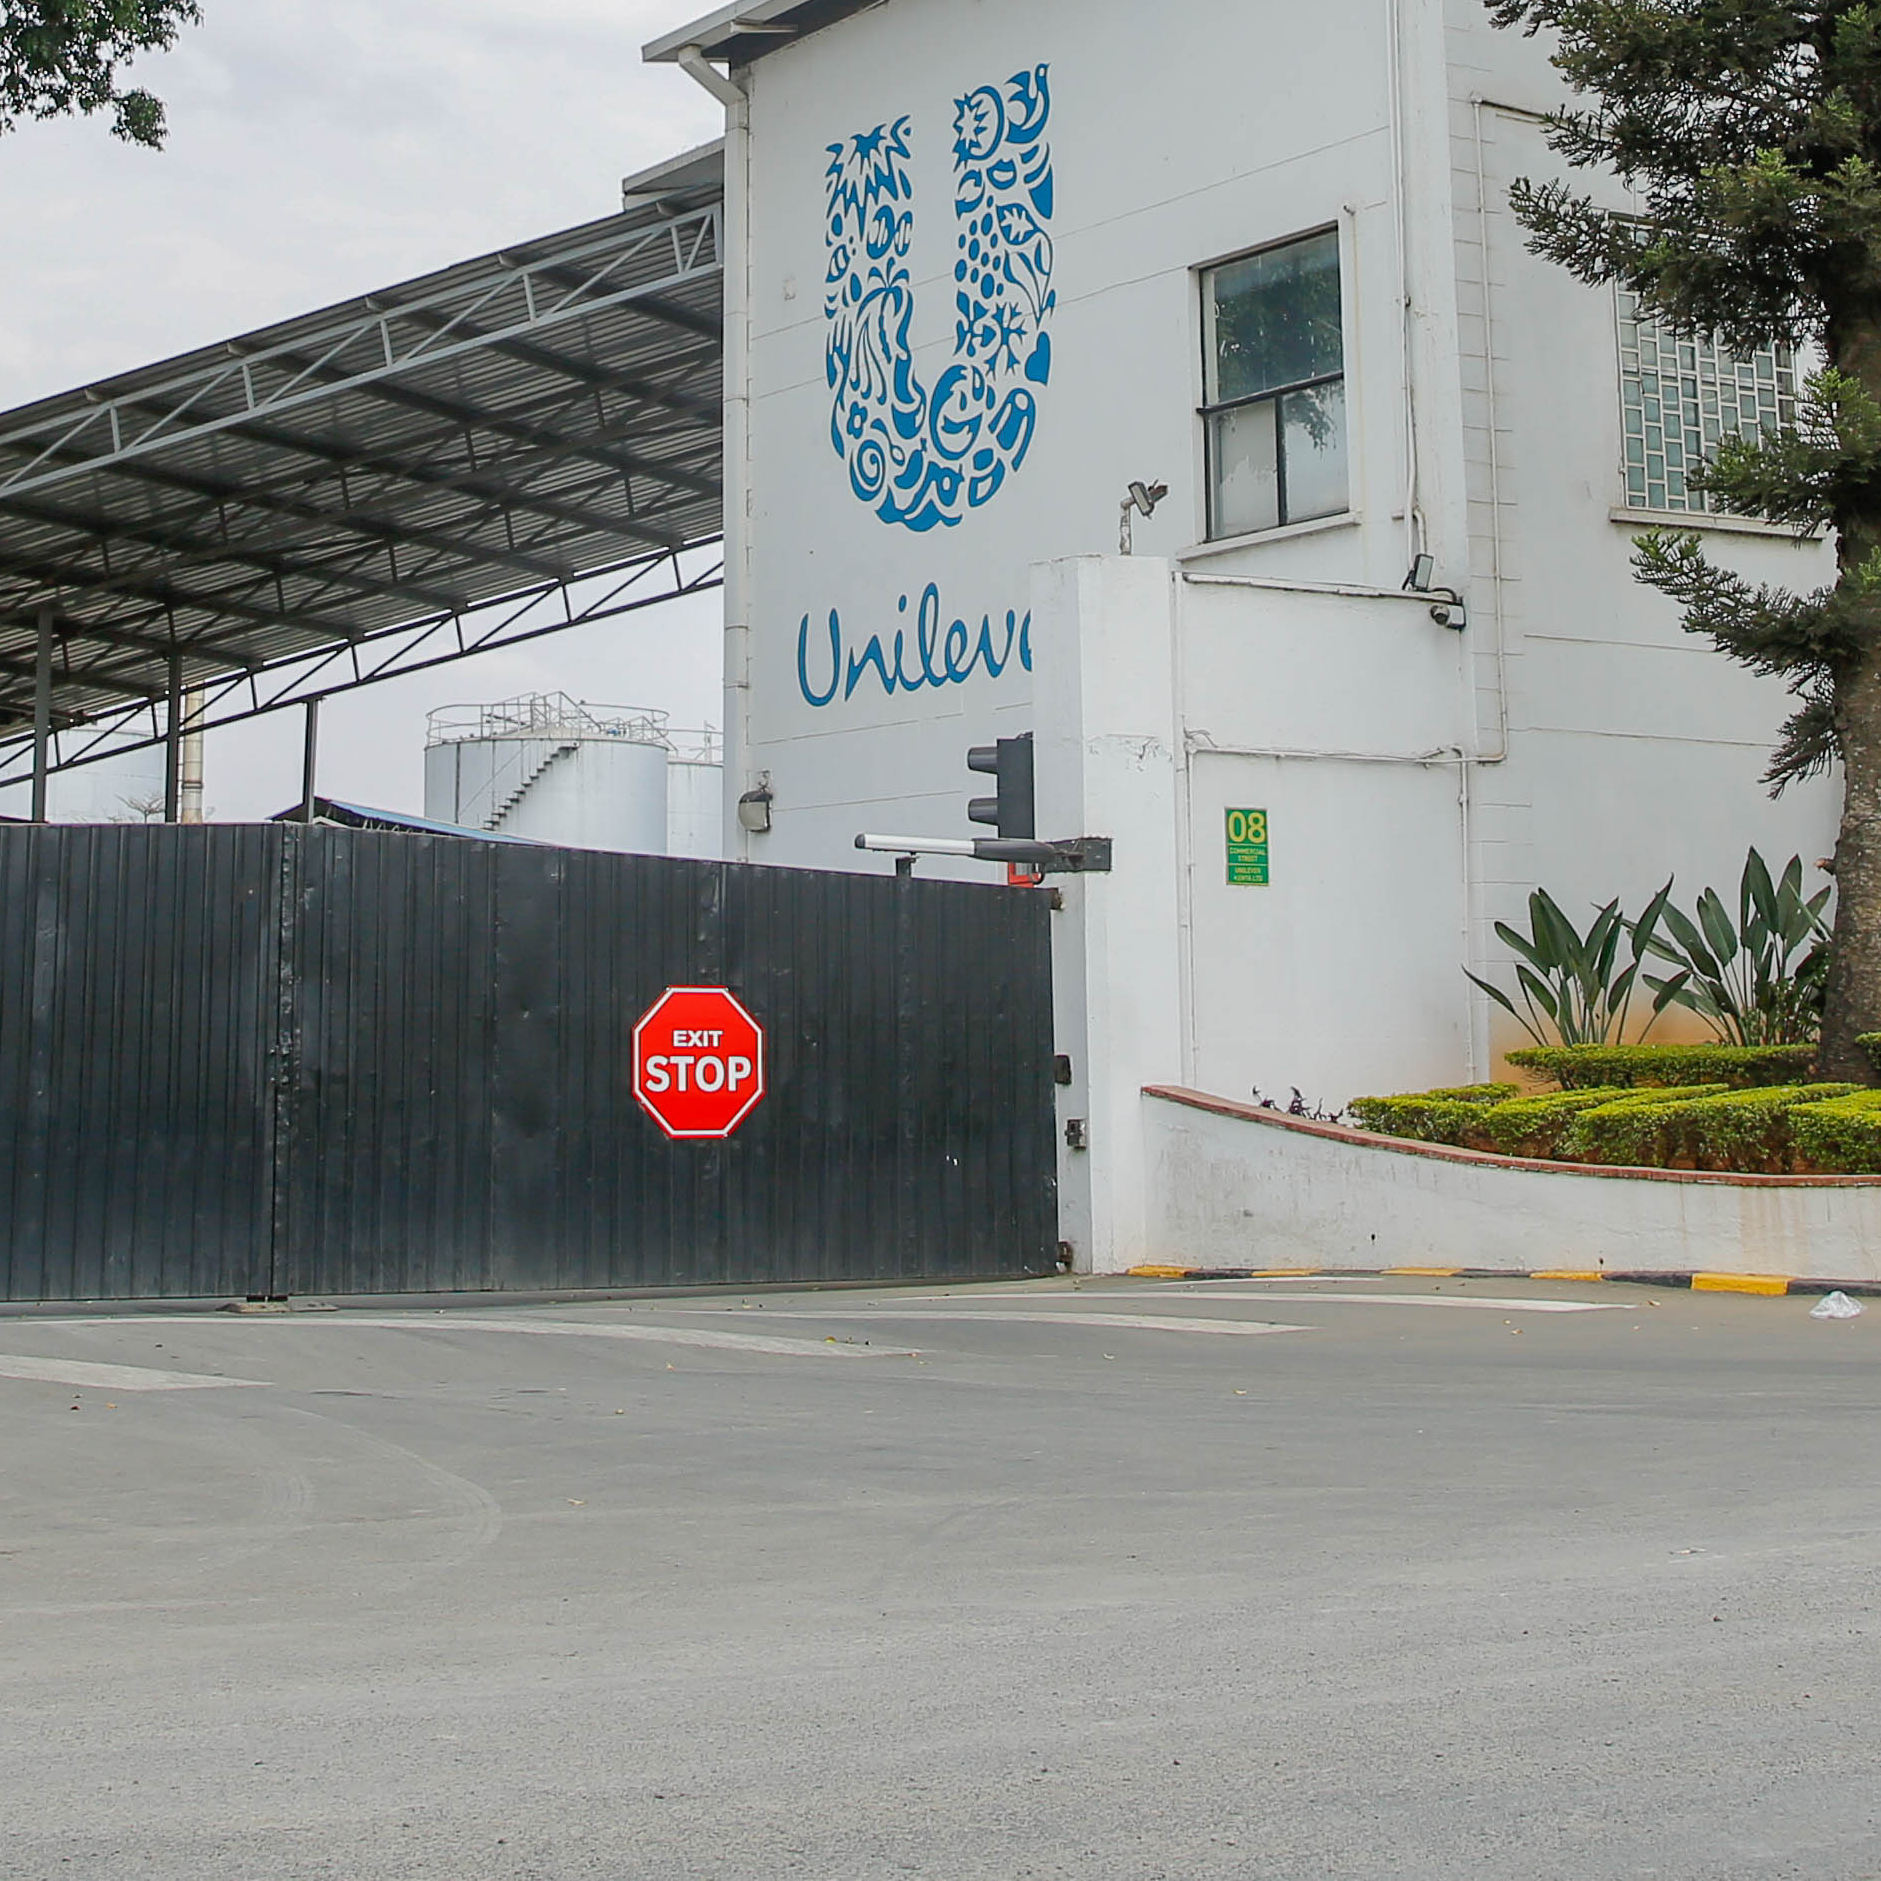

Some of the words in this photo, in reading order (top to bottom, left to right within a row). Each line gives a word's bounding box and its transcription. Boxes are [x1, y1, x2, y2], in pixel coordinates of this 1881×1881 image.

[1228, 811, 1266, 843] 08
[673, 1030, 723, 1047] EXIT
[645, 1055, 751, 1093] STOP
